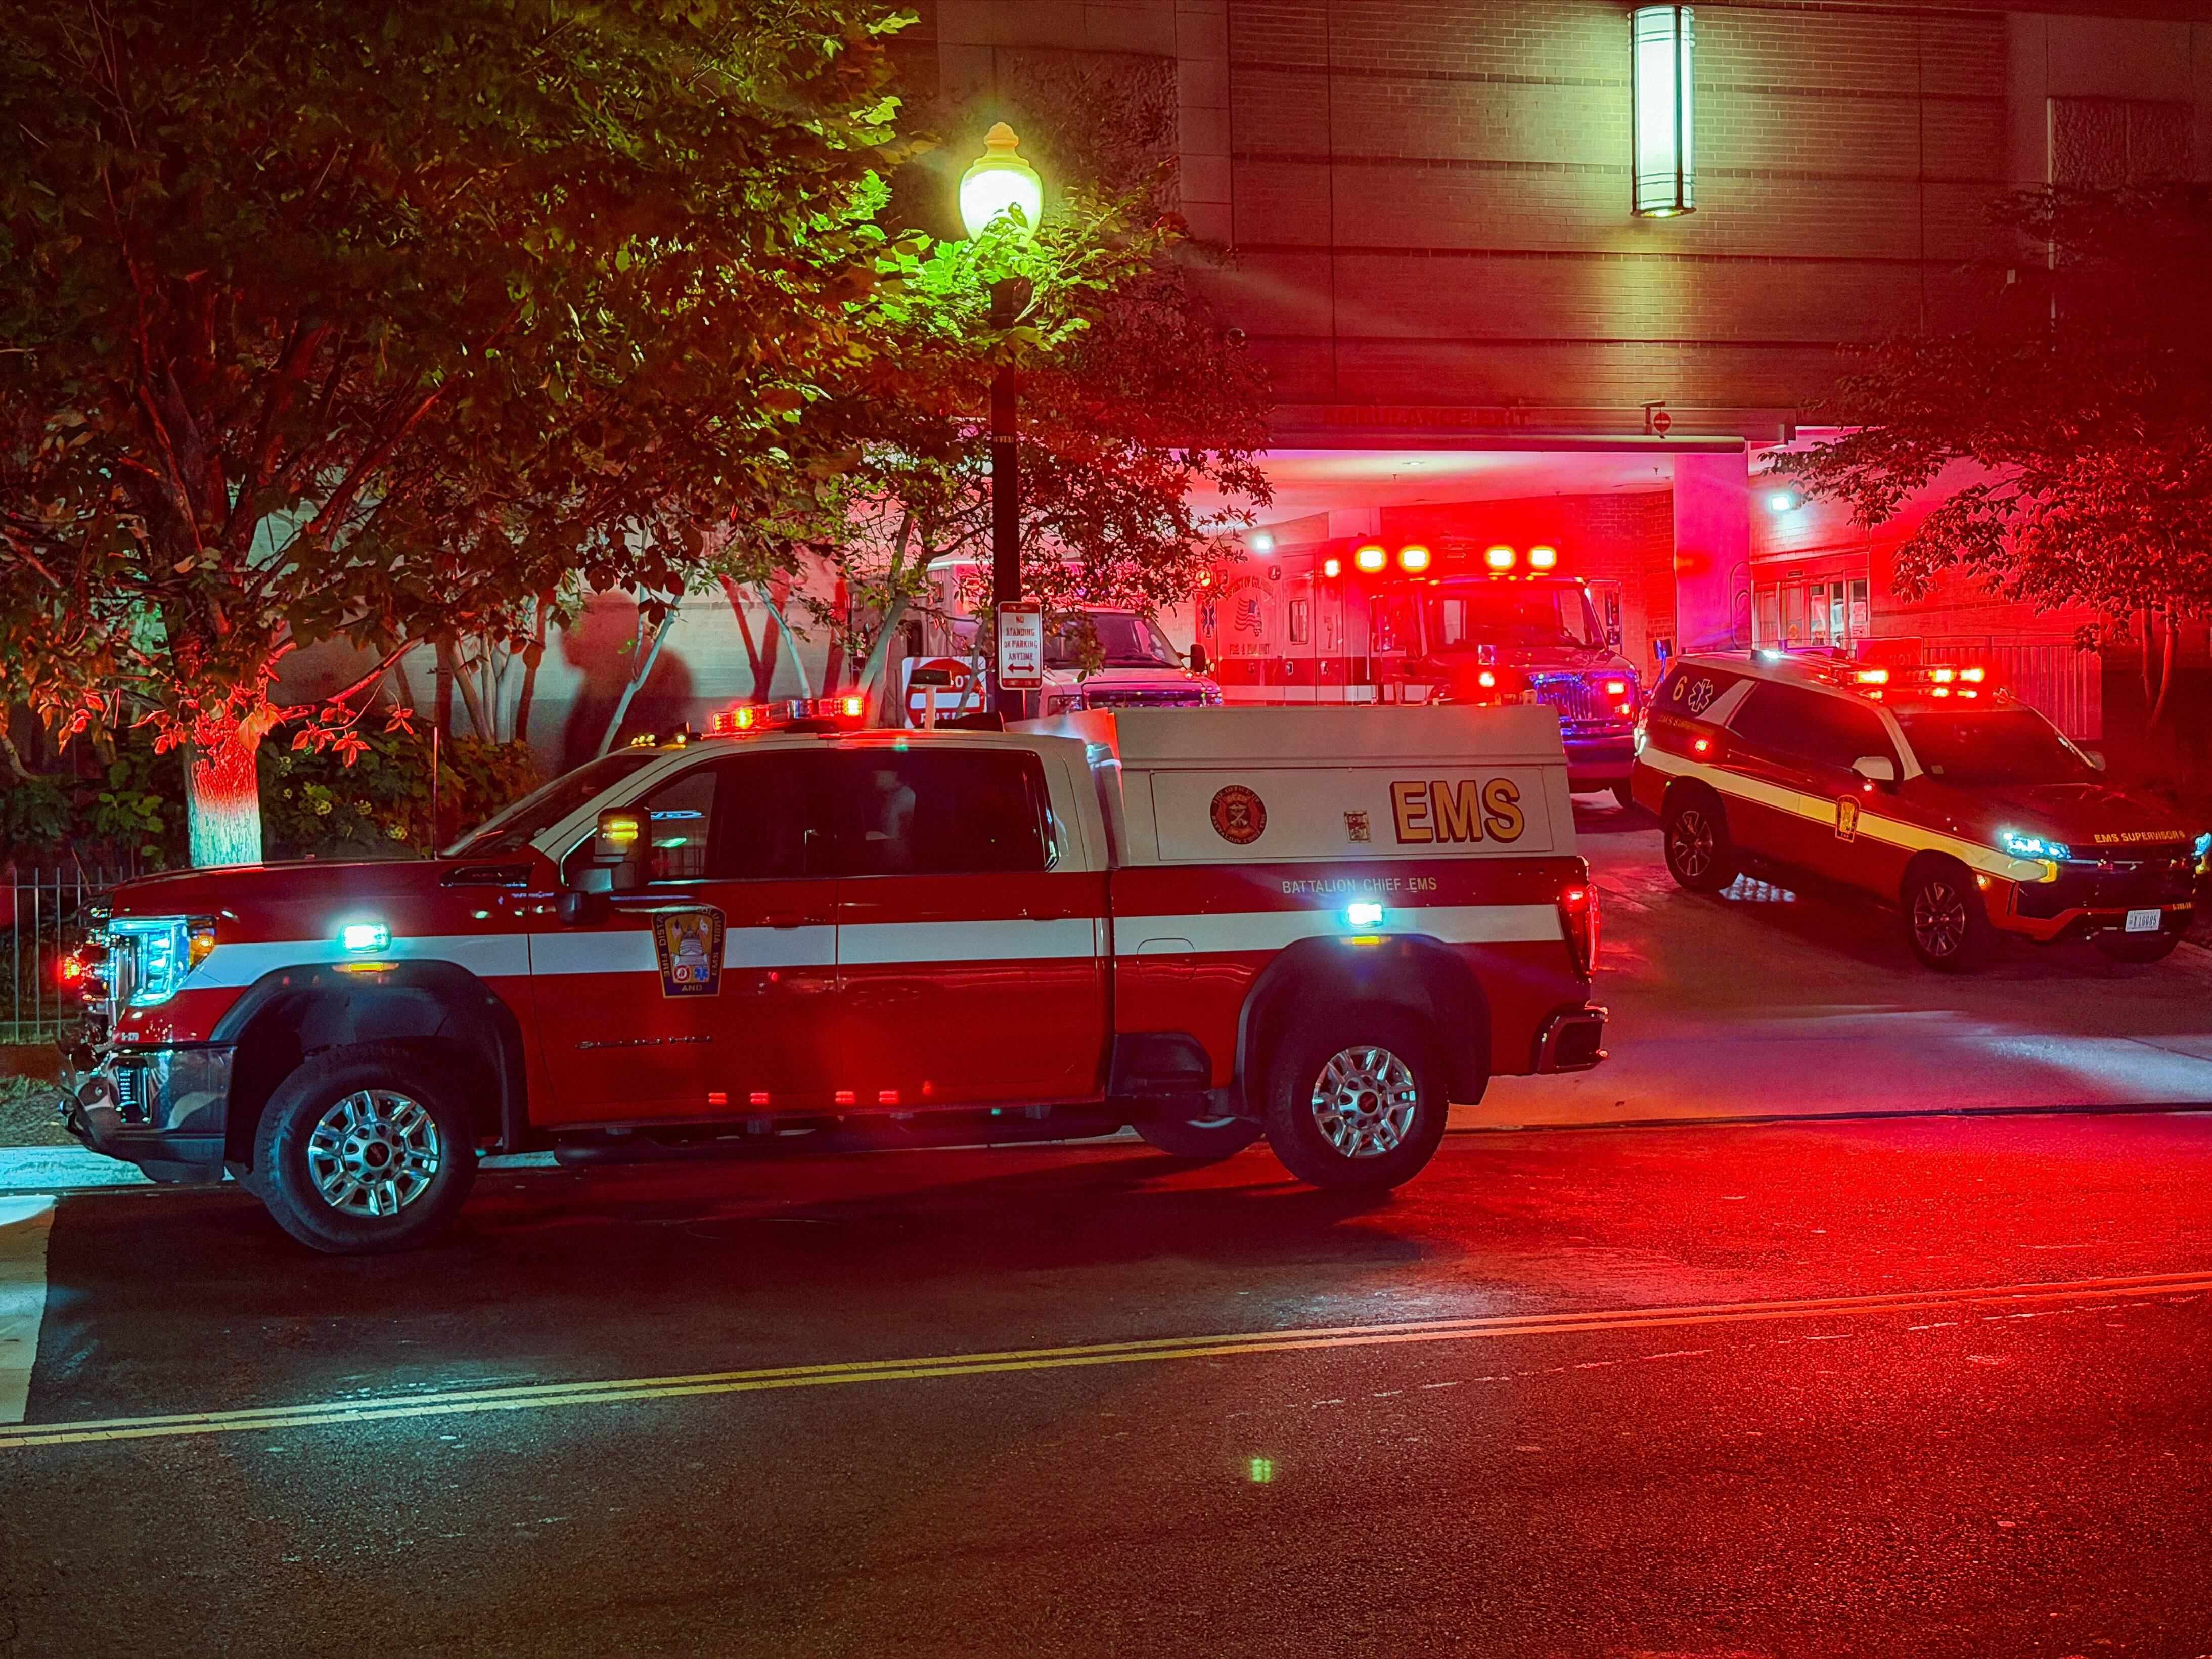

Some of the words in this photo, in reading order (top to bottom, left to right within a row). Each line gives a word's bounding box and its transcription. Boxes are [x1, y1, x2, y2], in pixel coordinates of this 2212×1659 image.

[1477, 409, 1528, 427] EXIT
[1016, 616, 1024, 624] NO
[1006, 627, 1035, 636] STANDING
[1012, 640, 1038, 649] PARKING
[1008, 652, 1033, 661] ANYTIME
[1673, 676, 1687, 701] 6
[1389, 778, 1525, 844] EMS
[2094, 833, 2119, 843] EMS
[2121, 830, 2180, 842] SUPERVISOR
[1282, 878, 1356, 894] BATTALION
[1363, 877, 1401, 891] CHIEF
[1409, 877, 1437, 890] EMS
